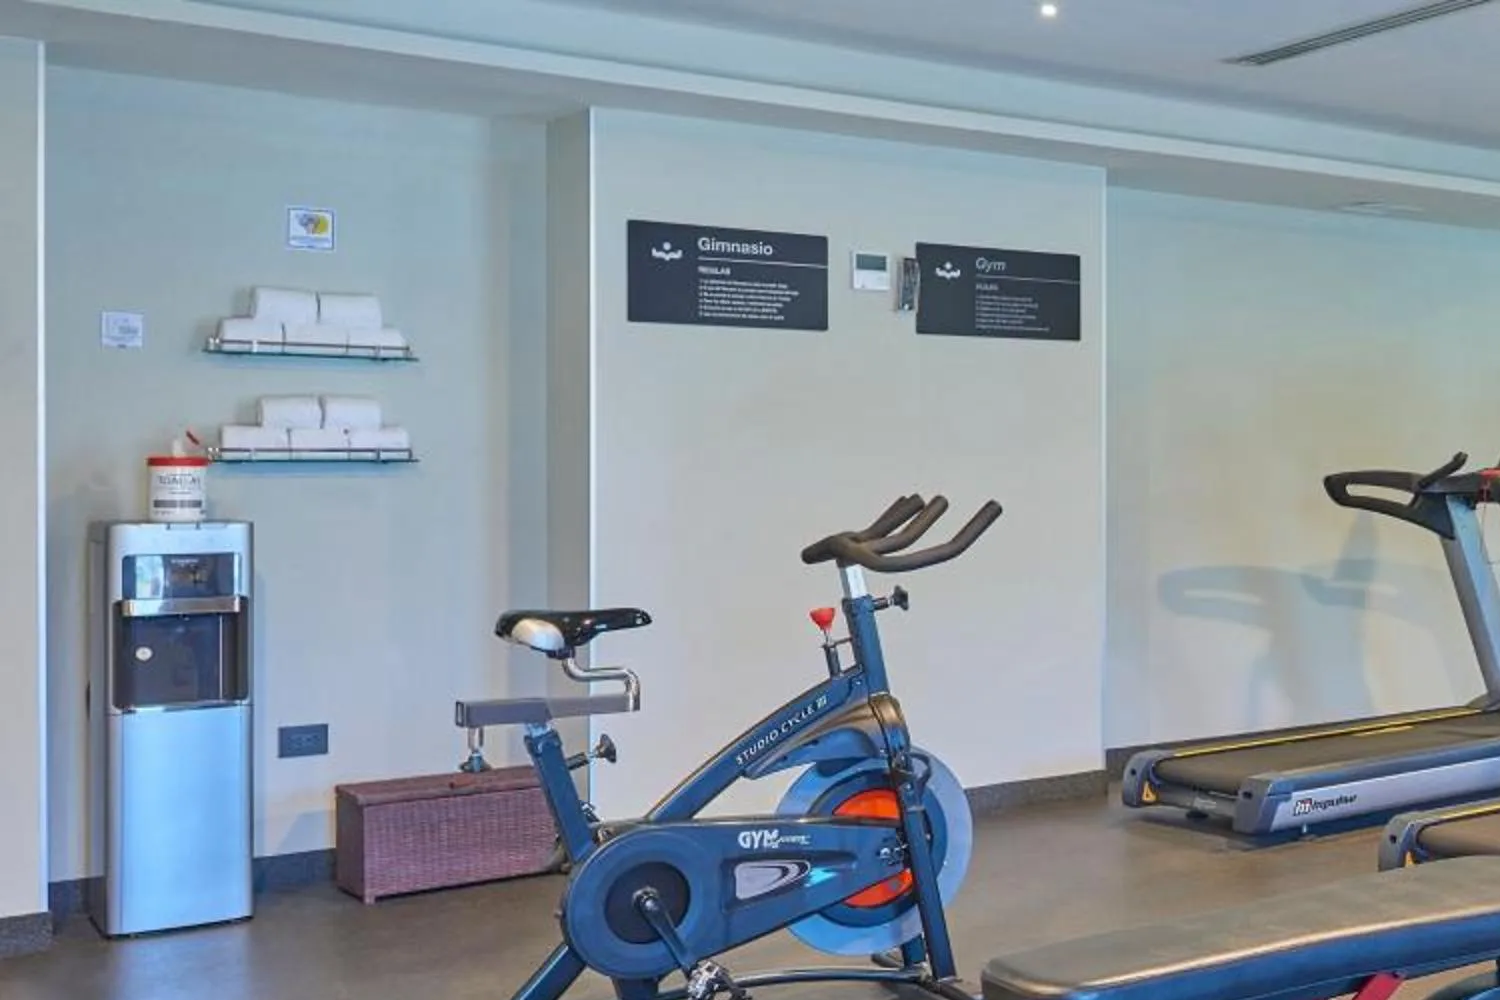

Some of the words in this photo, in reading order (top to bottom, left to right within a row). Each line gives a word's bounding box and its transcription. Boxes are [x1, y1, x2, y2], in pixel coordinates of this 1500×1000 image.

[697, 236, 774, 256] Gimnasio
[975, 256, 1006, 273] Gym
[736, 729, 779, 765] STUDIO
[781, 704, 815, 734] CYCLE
[738, 829, 779, 849] GYM
